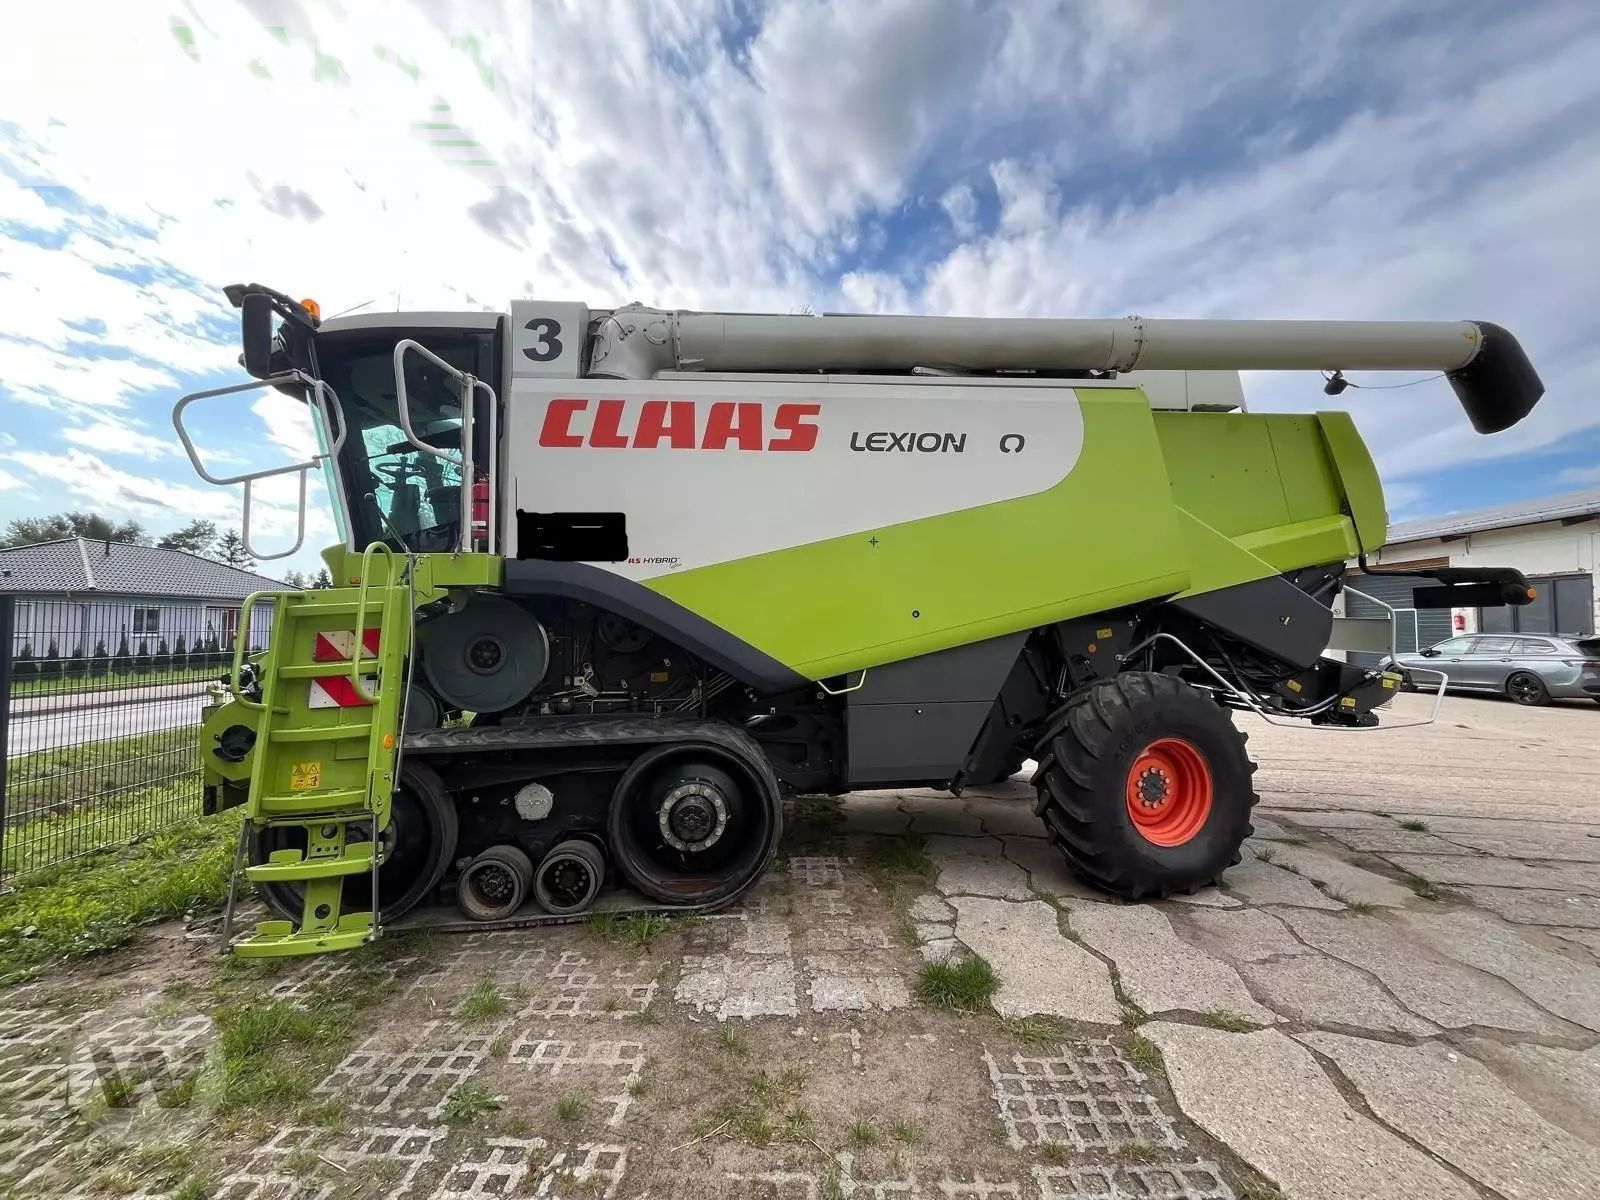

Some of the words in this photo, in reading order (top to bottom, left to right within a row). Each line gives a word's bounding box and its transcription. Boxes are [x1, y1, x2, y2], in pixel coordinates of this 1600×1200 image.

[523, 318, 563, 362] 3
[538, 398, 821, 452] CLAAS
[850, 431, 967, 453] LEXION
[642, 557, 679, 566] HYBRID
